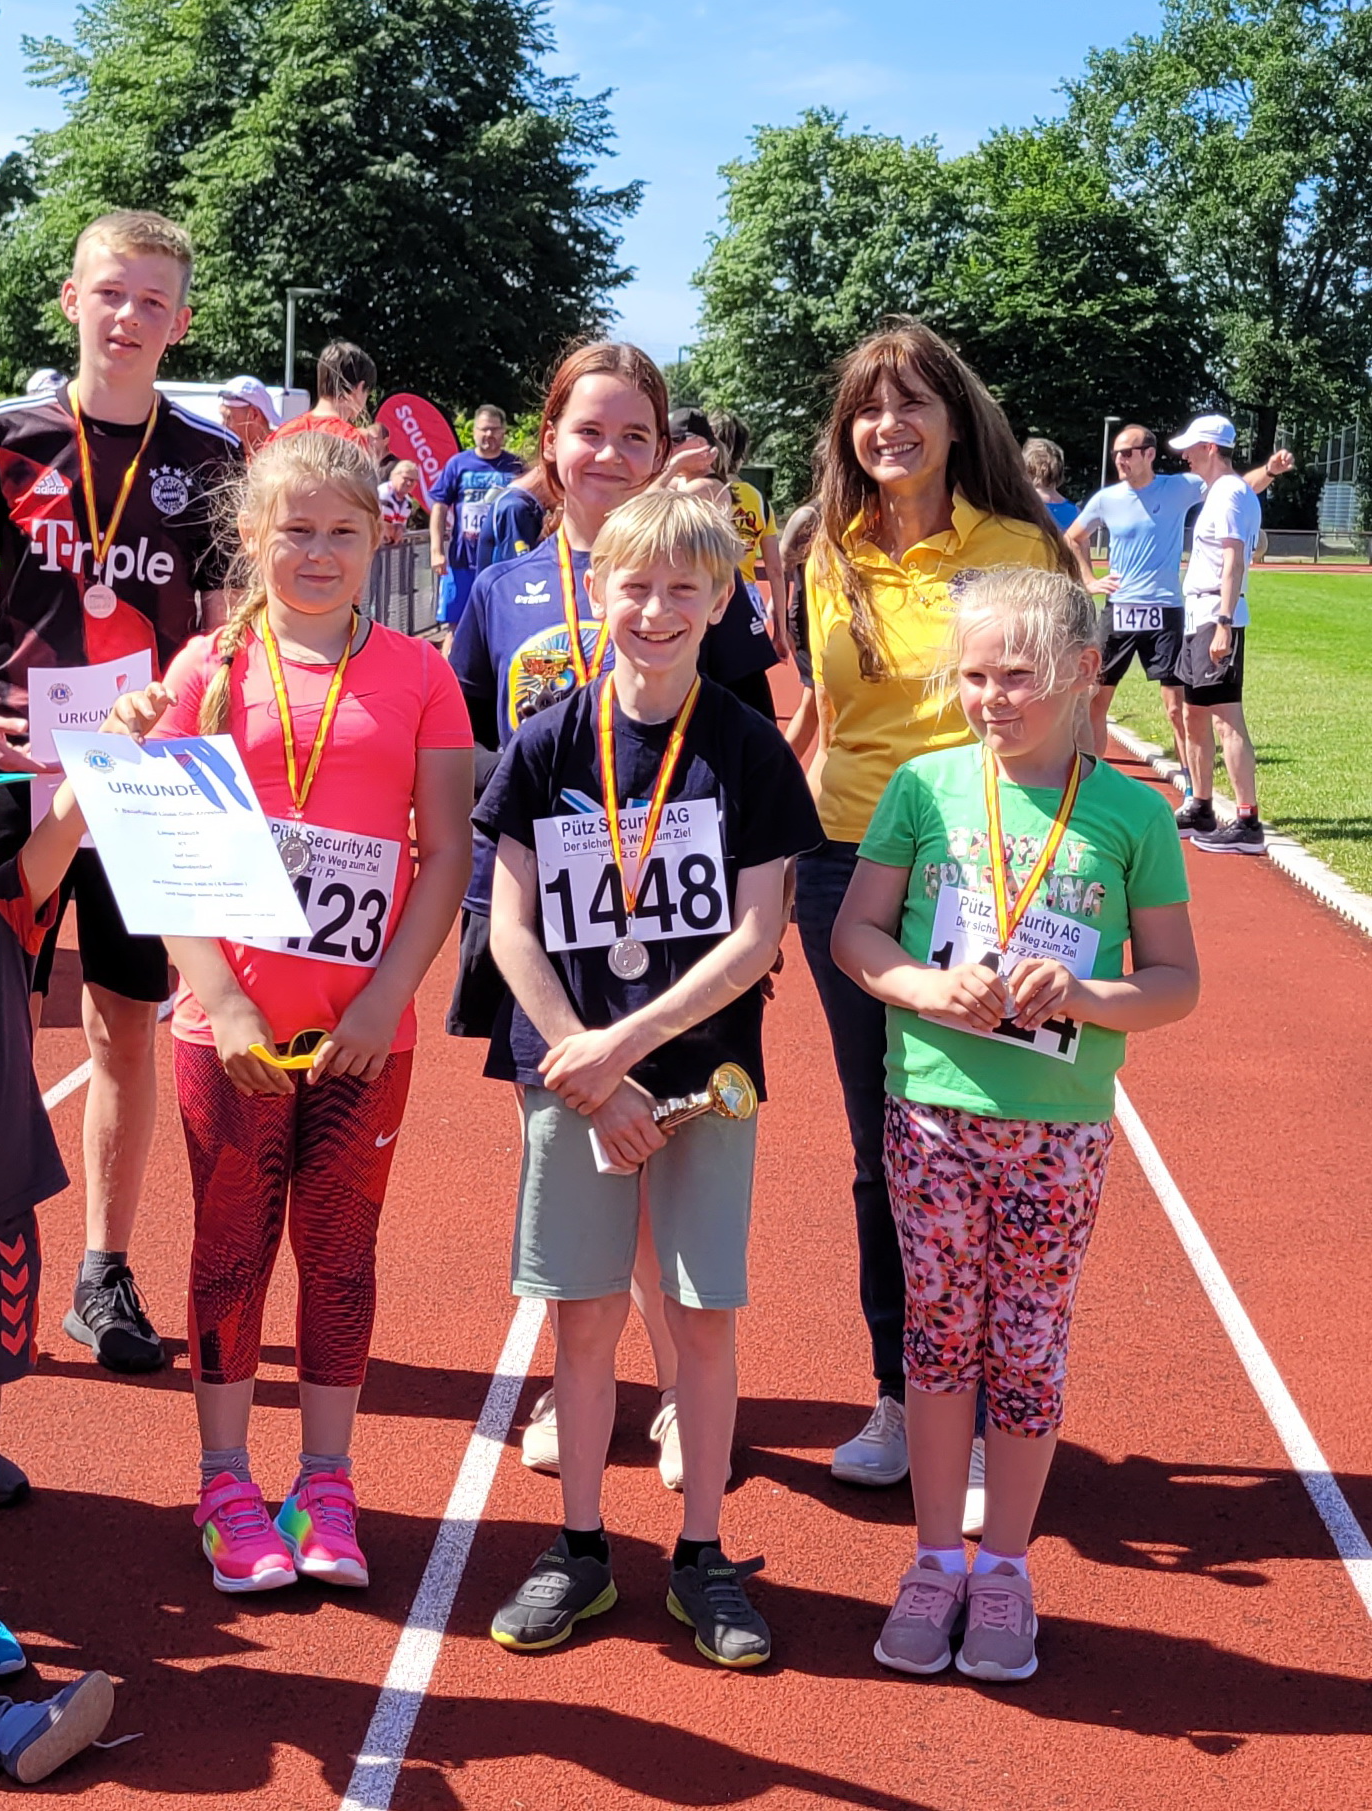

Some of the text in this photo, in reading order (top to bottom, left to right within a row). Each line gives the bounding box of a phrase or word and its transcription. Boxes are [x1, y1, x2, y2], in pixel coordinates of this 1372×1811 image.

[1115, 606, 1162, 630] 1478
[58, 708, 114, 724] URKUN
[107, 781, 201, 797] URKUNDE
[560, 820, 595, 838] Pütz
[665, 807, 690, 826] AG
[305, 831, 364, 860] Security
[364, 841, 382, 859] AG
[563, 842, 581, 853] Der
[673, 827, 692, 839] Ziel
[328, 854, 347, 870] Weg
[349, 861, 366, 872] zum
[366, 861, 380, 873] Ziel
[545, 853, 723, 944] 1448
[959, 896, 992, 918] Pütz
[1060, 924, 1081, 944] AG
[955, 915, 969, 929] Der
[1019, 930, 1040, 948] Weg
[1042, 939, 1061, 953] zum
[1061, 943, 1077, 959] Ziel
